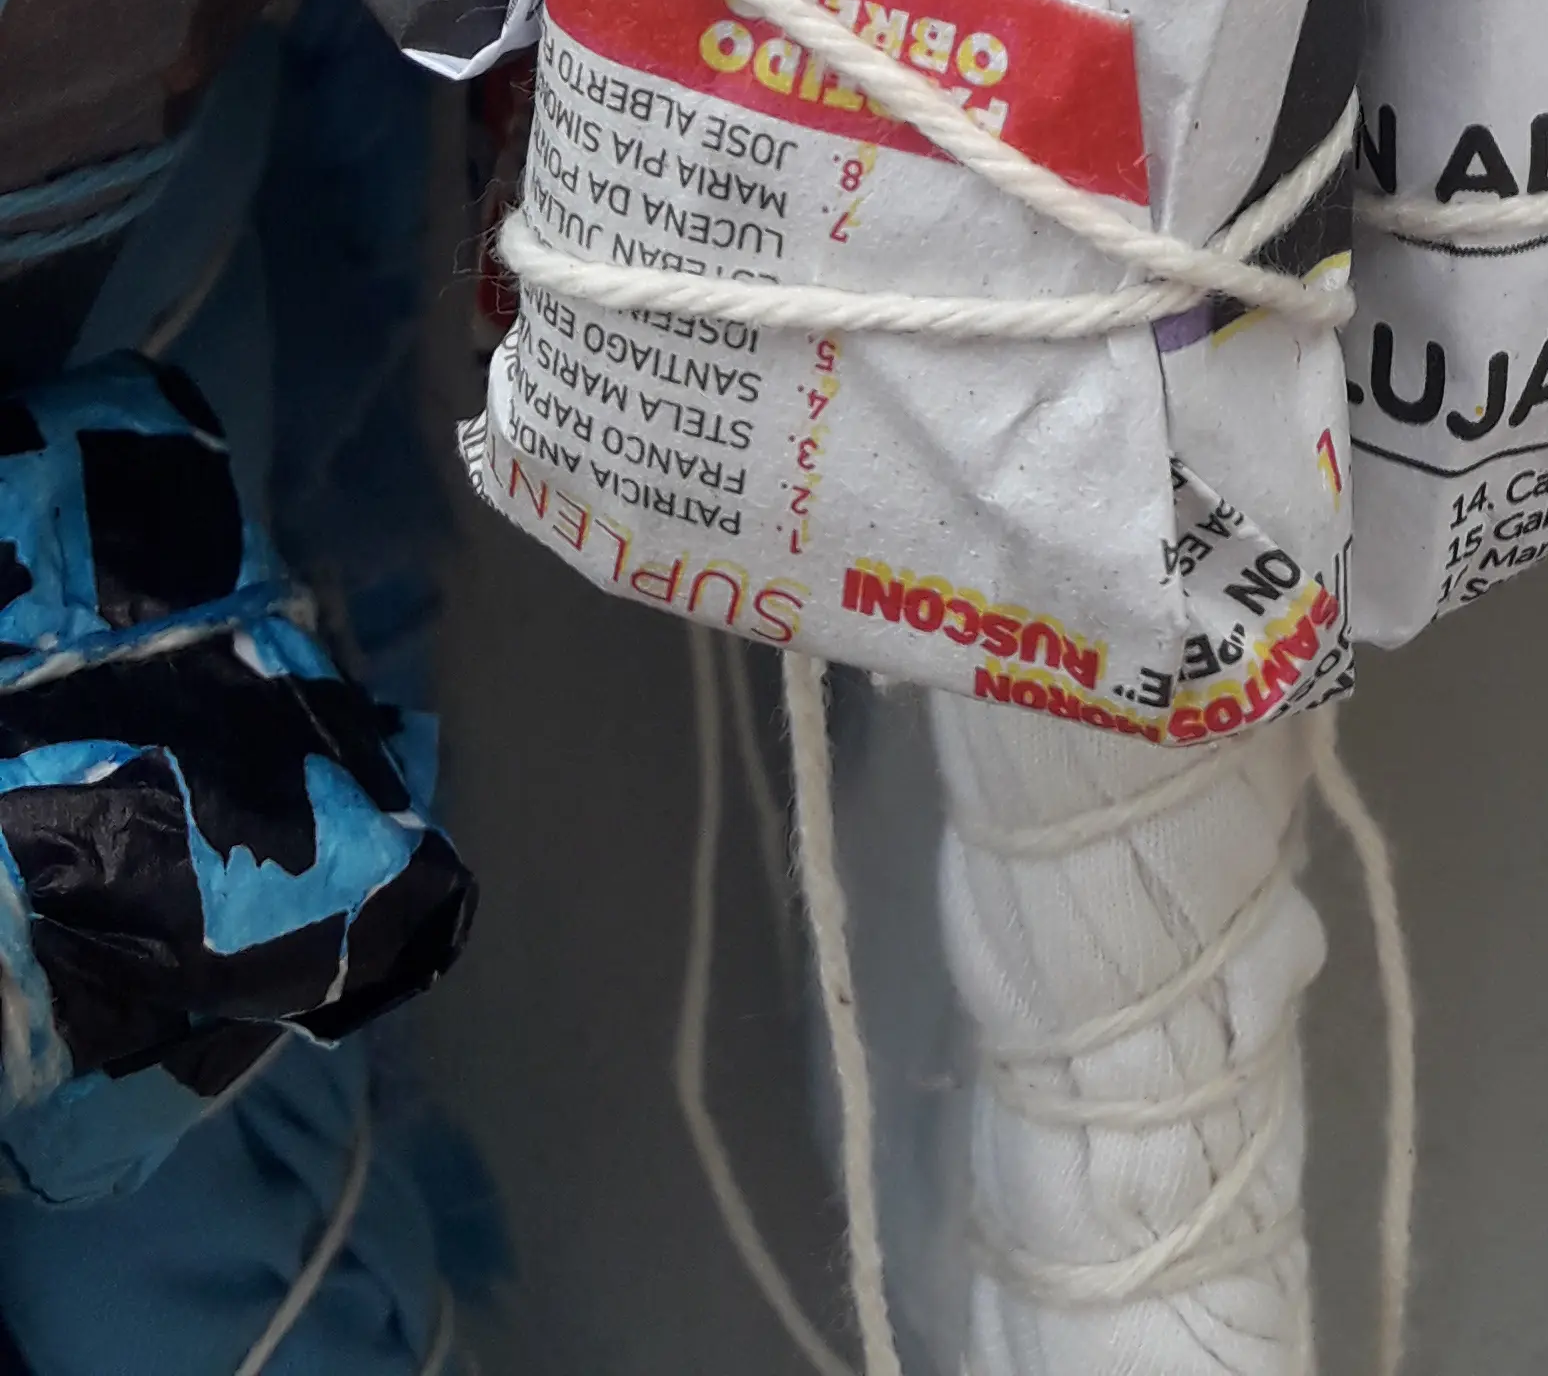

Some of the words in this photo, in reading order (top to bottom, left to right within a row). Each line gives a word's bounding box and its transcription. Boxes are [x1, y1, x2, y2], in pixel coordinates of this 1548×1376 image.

[558, 49, 698, 138] ALBERTO
[611, 130, 667, 179] PIA
[700, 115, 799, 171] JOSE
[588, 170, 632, 218] DA
[676, 154, 788, 219] MARIA
[832, 153, 864, 193] 8.
[641, 192, 784, 259] LUCENA
[820, 205, 851, 244] 7.
[537, 338, 627, 413] MARIS
[583, 323, 762, 405] SANTIAGO
[806, 334, 838, 374] 5.
[639, 390, 754, 451] STELA
[798, 385, 830, 421] 4.
[602, 426, 747, 496] FRANCO
[788, 434, 819, 472] 3.
[591, 459, 741, 536] PATRICIA
[782, 482, 813, 516] 2.
[1448, 481, 1495, 529] 14.
[840, 563, 1103, 692] RUSCONI
